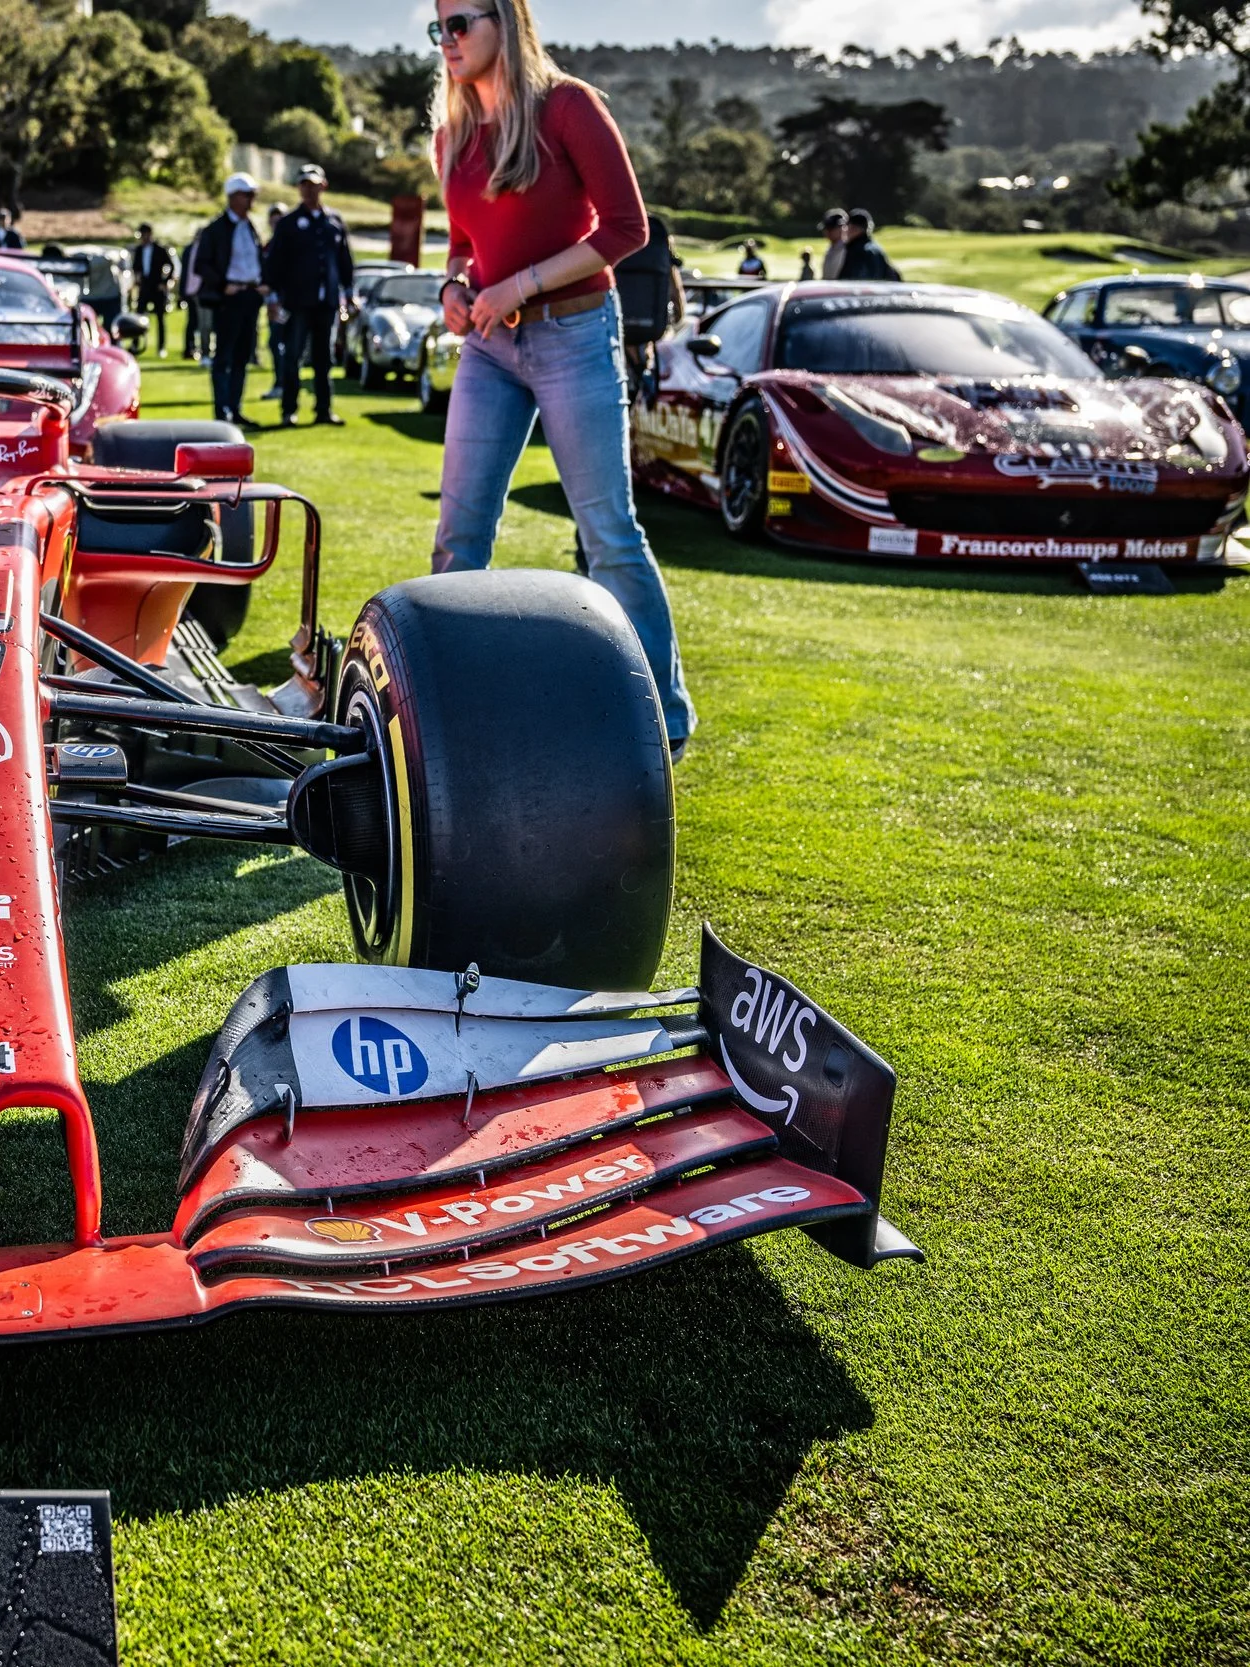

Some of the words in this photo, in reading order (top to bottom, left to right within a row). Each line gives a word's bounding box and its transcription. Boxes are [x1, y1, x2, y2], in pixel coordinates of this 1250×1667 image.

[993, 454, 1158, 482] CLABOTS
[940, 535, 1119, 562] Francorchamps
[1124, 539, 1188, 558] Motors
[347, 1017, 413, 1096] hp
[731, 968, 817, 1073] aws
[372, 1153, 648, 1237] V-Power
